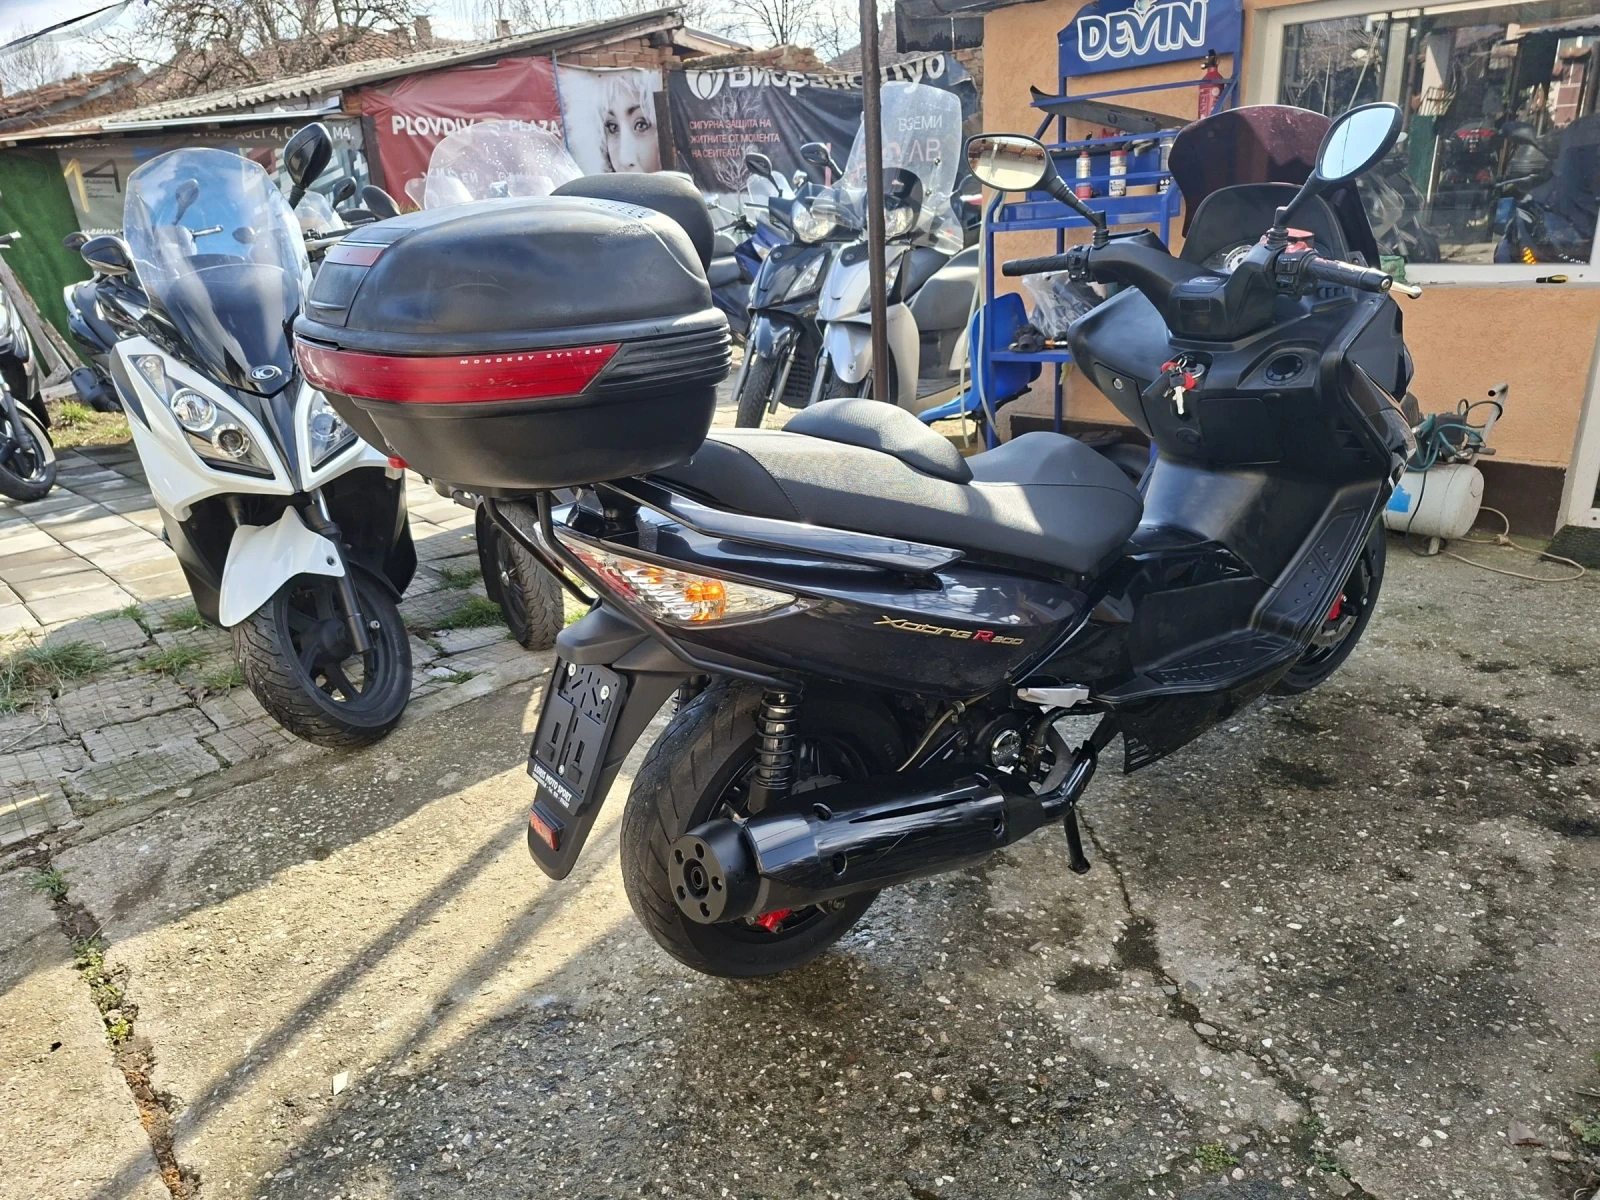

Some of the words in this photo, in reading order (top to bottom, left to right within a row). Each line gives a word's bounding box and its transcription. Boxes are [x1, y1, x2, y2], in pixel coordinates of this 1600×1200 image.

[1077, 0, 1208, 61] DEVIN
[392, 116, 474, 136] PLOVDIV
[508, 119, 562, 136] PLAZA
[689, 120, 724, 130] СИГУРНА
[725, 119, 758, 130] ЗАЩИТА
[759, 118, 772, 128] НА
[728, 133, 740, 143] ОТ
[741, 133, 780, 143] МОМЕНТА
[691, 149, 702, 159] НА
[460, 355, 534, 365] MONOKEY
